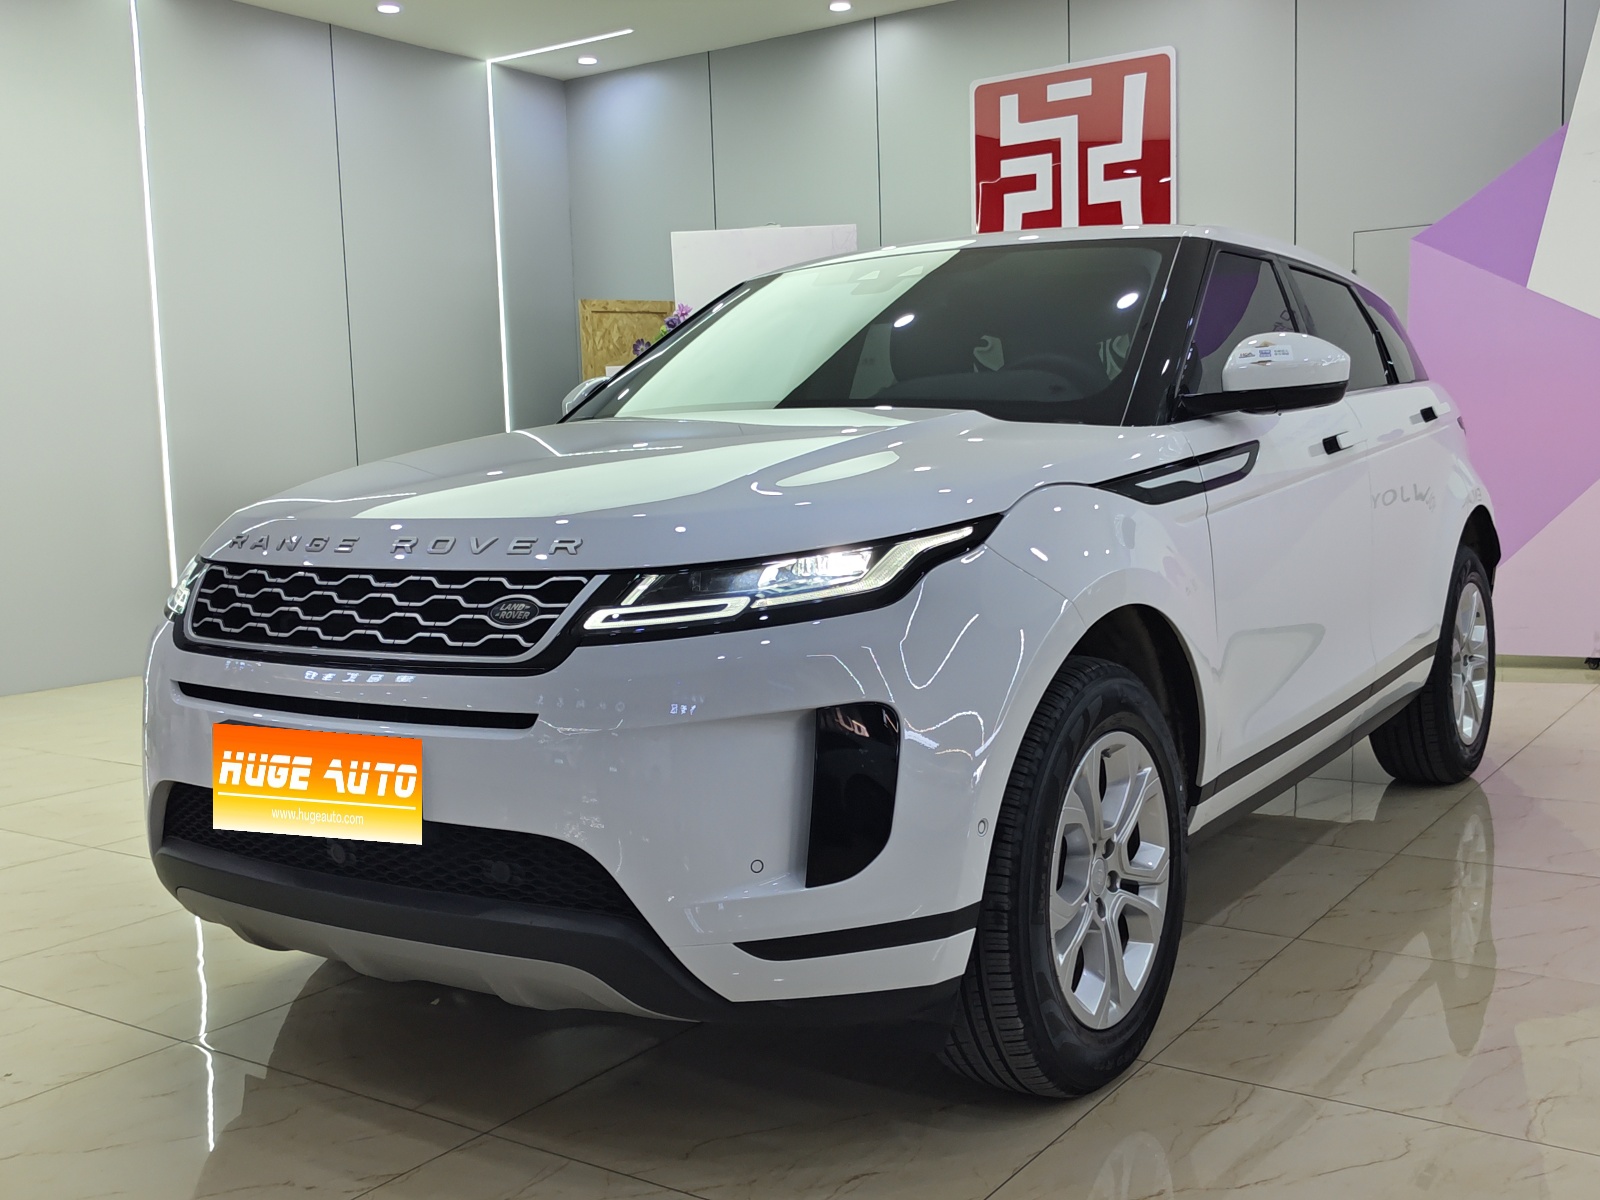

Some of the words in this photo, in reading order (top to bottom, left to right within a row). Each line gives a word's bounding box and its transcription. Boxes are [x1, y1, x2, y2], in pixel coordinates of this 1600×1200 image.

[229, 533, 361, 554] RANGE
[390, 535, 584, 556] ROVER
[499, 611, 531, 619] ROVER
